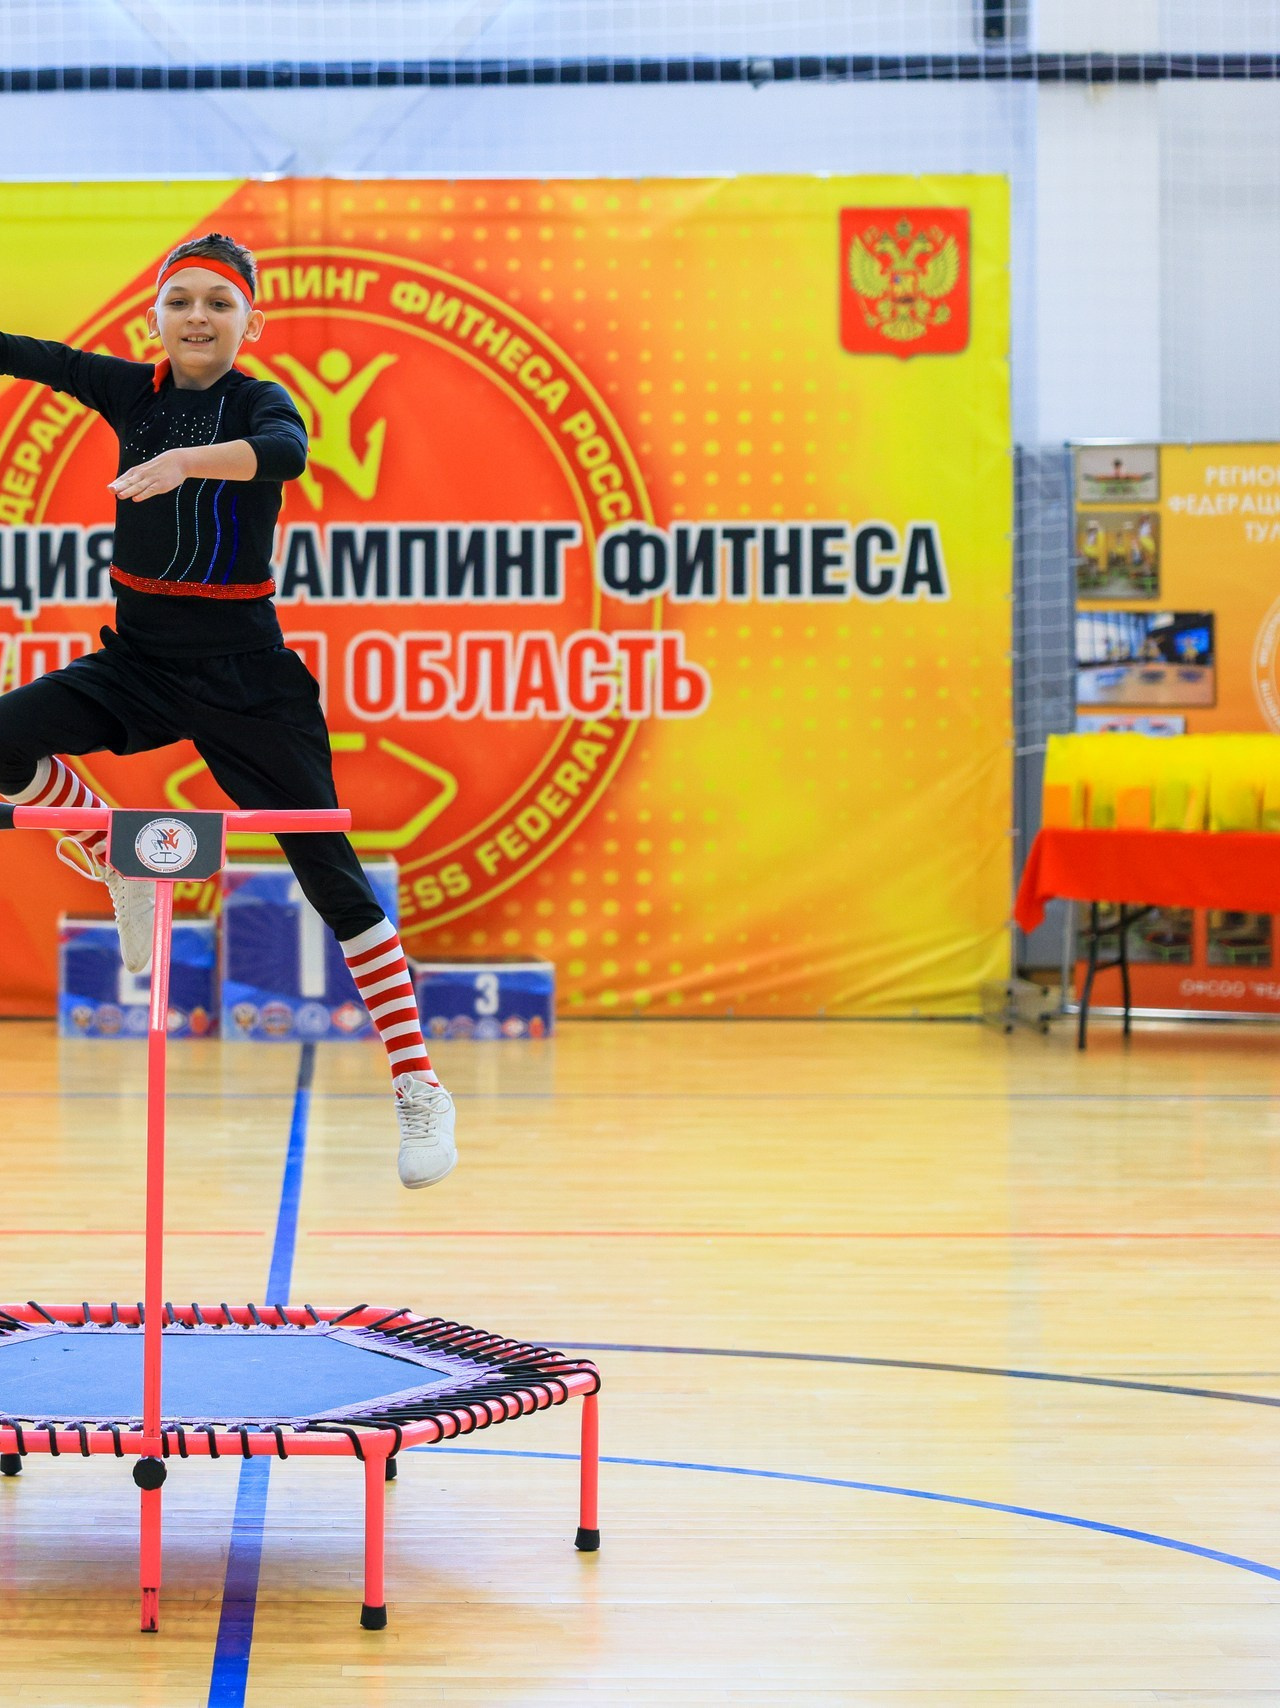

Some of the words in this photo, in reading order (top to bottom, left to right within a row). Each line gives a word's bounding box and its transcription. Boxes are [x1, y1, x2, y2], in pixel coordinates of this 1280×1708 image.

[390, 280, 571, 415] ФИТНЕСА
[561, 408, 634, 529] РОСС
[273, 524, 580, 602] АМПИНГ
[601, 523, 949, 601] ФИТНЕСА
[347, 632, 710, 720] ОБЛАСТЬ
[475, 700, 618, 877] FEDERAT
[474, 972, 500, 1016] 3
